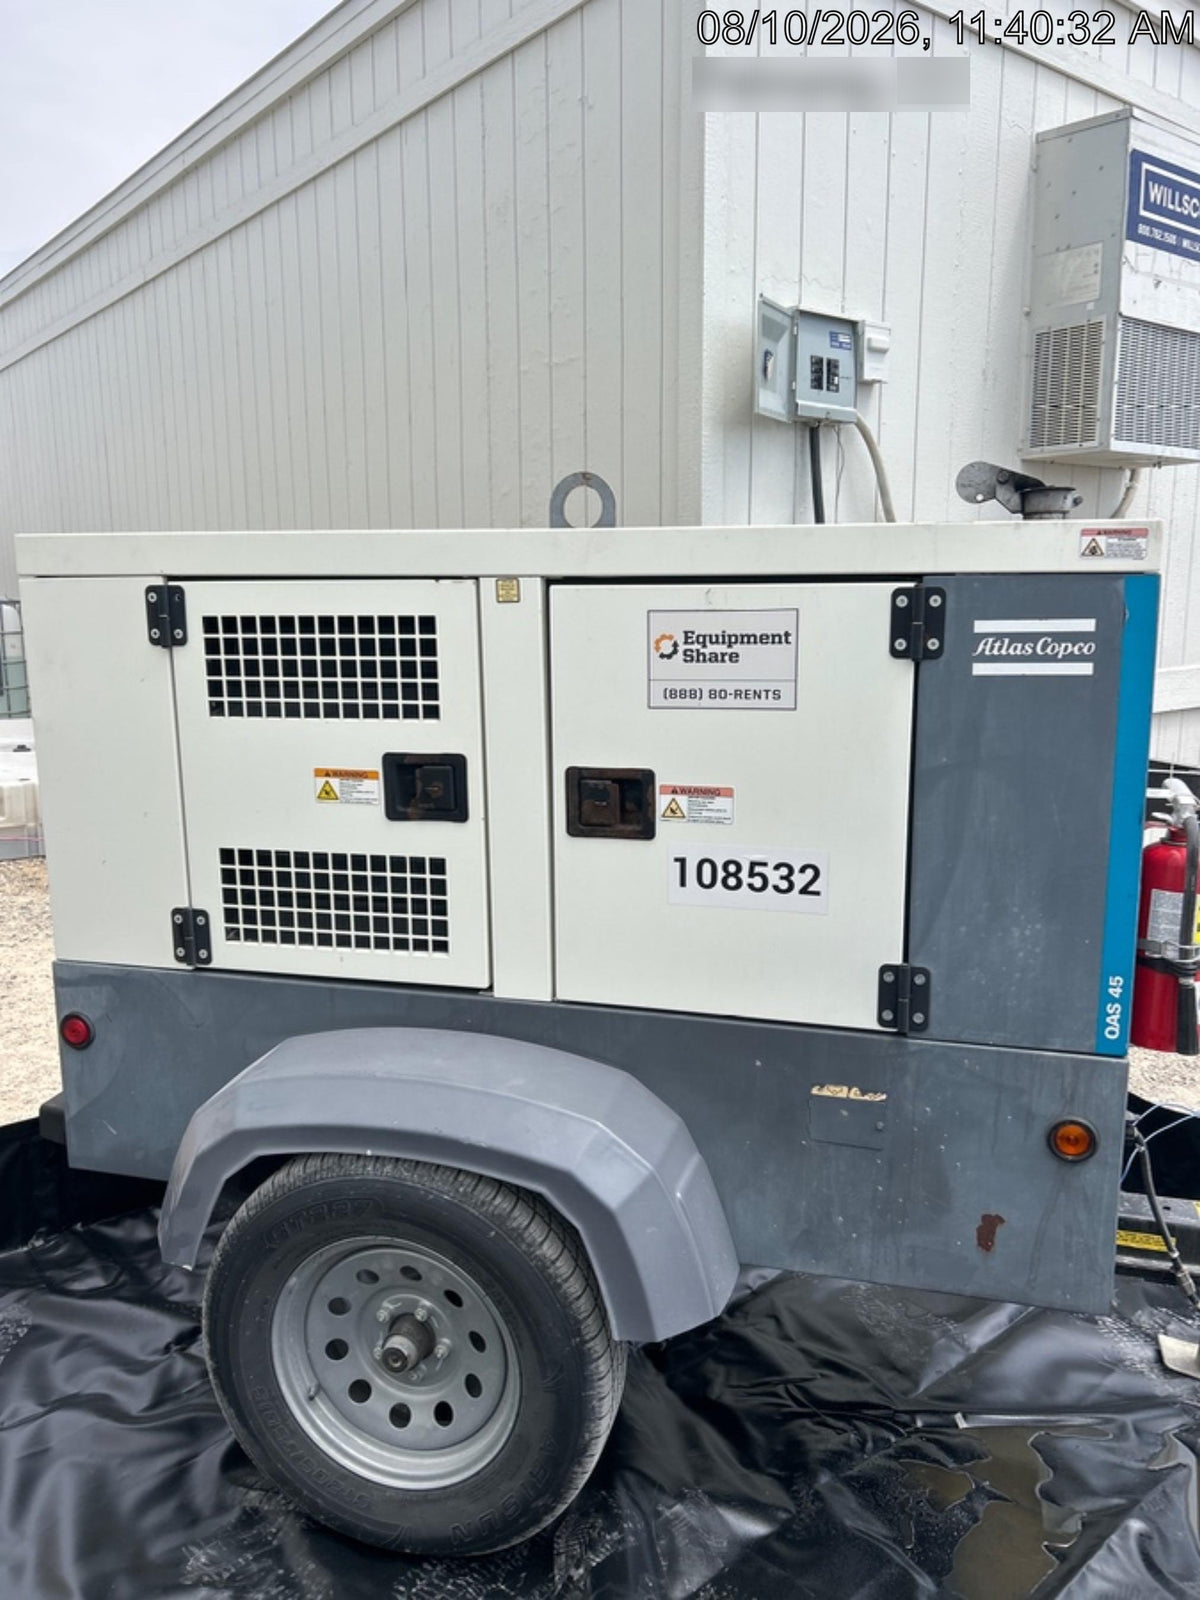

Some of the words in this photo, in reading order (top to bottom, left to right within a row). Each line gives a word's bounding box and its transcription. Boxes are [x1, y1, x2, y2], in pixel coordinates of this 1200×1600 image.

[682, 629, 792, 649] Equipment
[972, 637, 1034, 656] Atlas
[1036, 636, 1096, 659] Copco
[682, 648, 741, 664] Share
[663, 687, 703, 701] (888)
[708, 688, 782, 701] 80-RENTS
[680, 786, 721, 797] WARNING
[673, 856, 821, 897] 108532
[1108, 975, 1124, 998] 45
[1104, 1002, 1122, 1040] QAS
